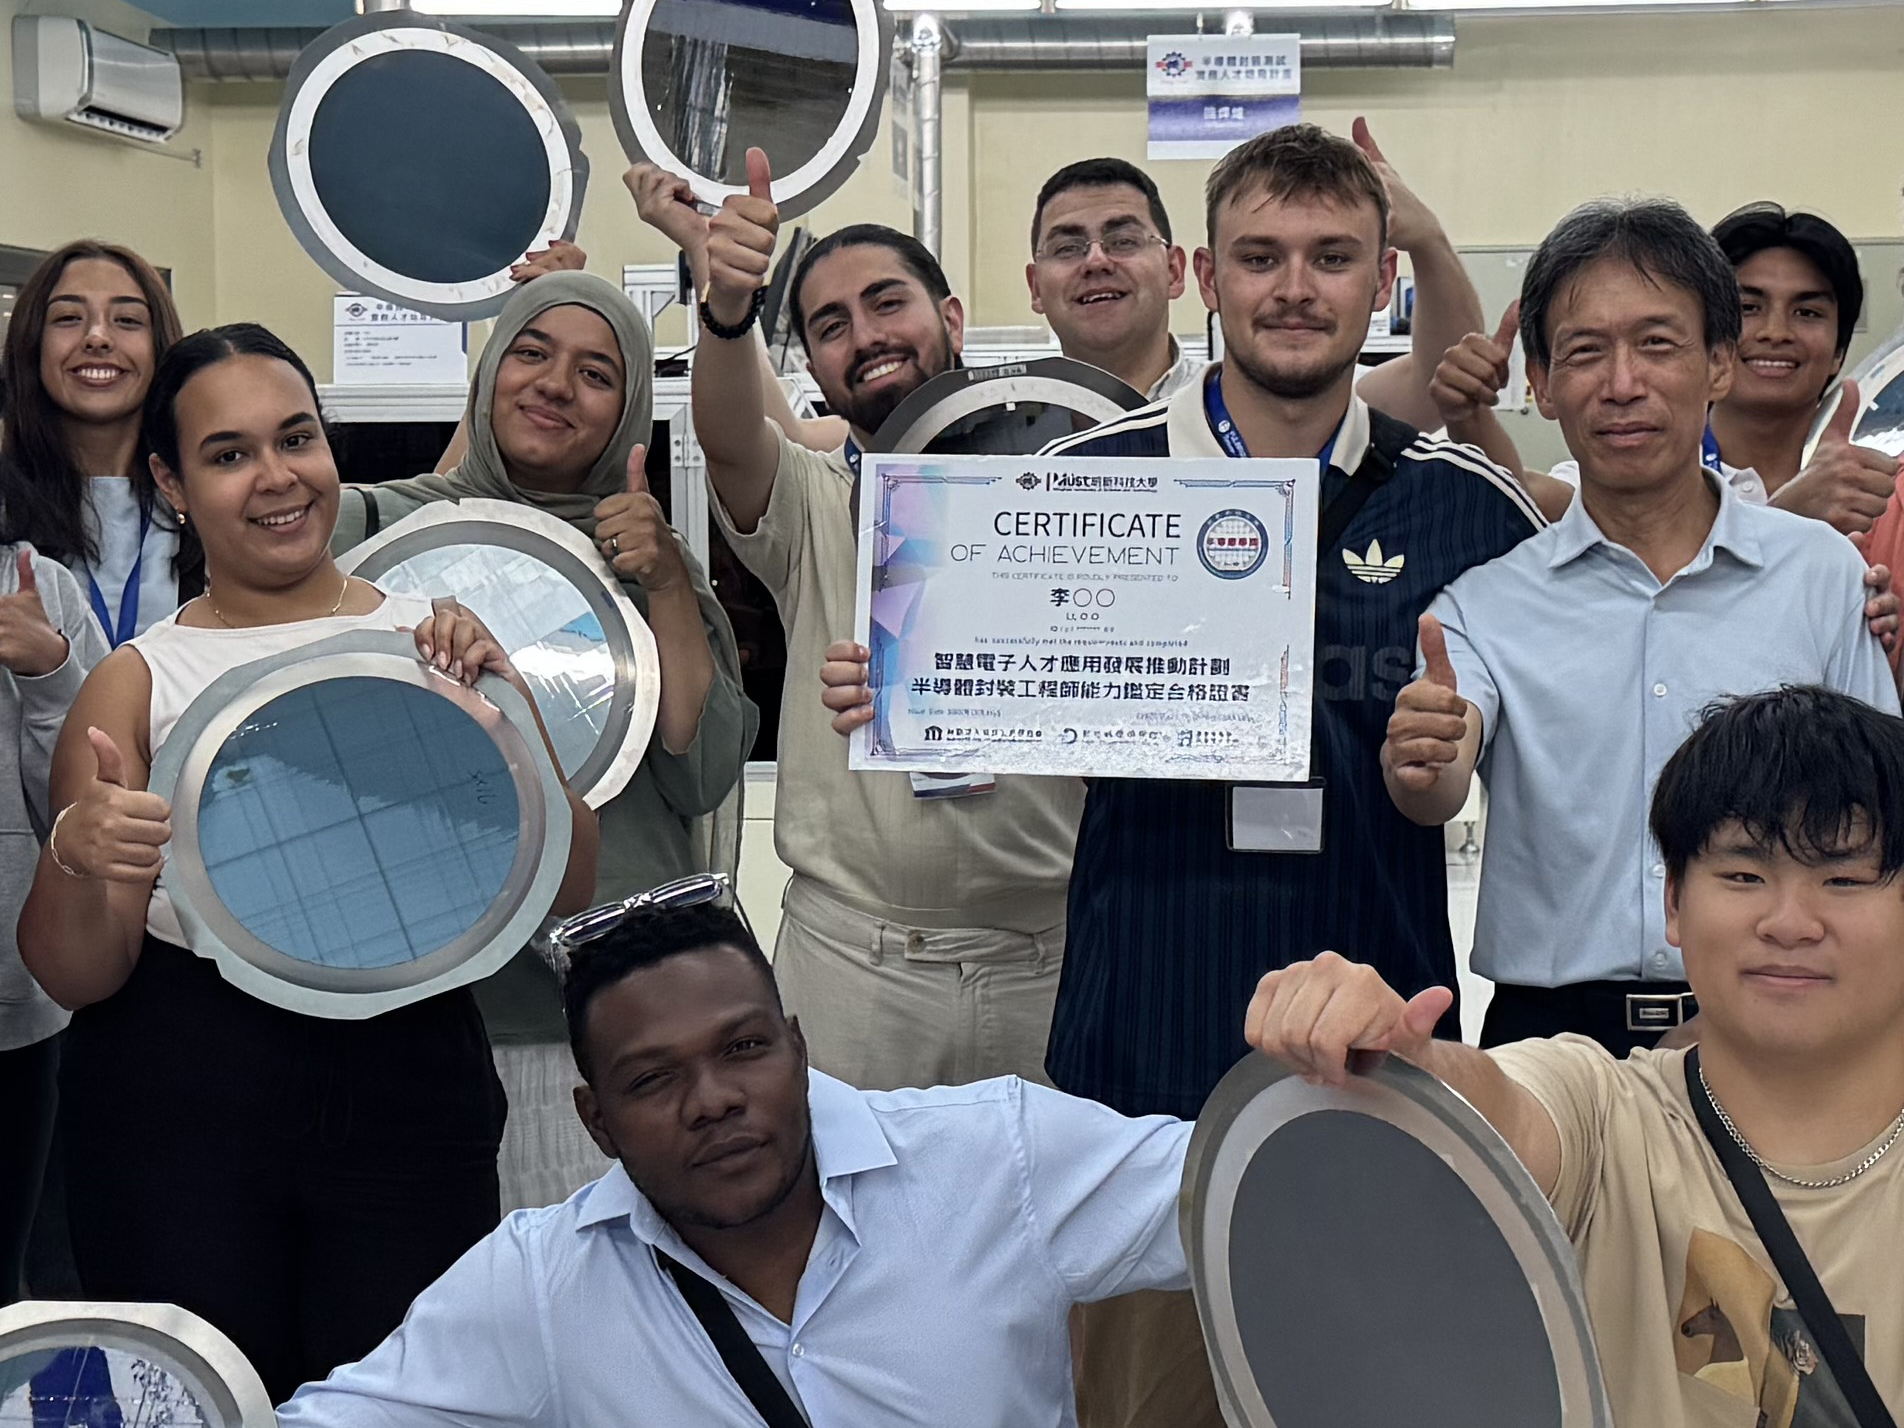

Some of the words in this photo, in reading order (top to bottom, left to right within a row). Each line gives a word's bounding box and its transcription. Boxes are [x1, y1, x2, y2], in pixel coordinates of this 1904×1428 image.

[994, 510, 1182, 540] CERTIFICATE
[949, 543, 987, 563] OF
[997, 544, 1181, 566] ACHIEVEMENT
